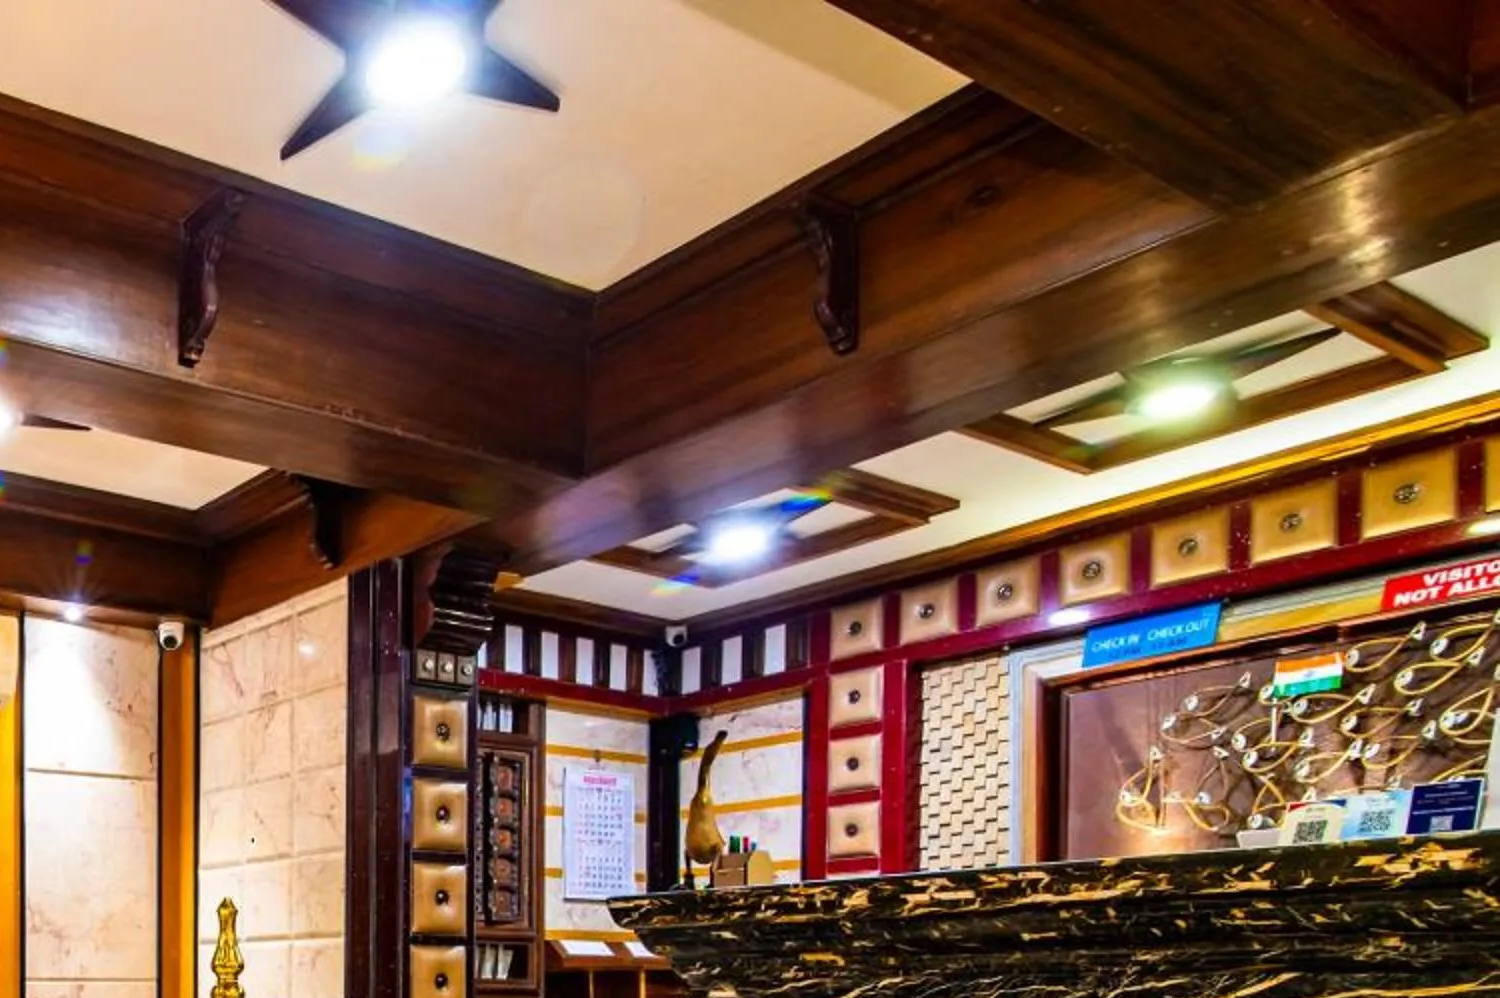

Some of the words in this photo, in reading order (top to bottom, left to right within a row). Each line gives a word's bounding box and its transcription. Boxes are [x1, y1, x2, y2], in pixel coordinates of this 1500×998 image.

[1423, 560, 1500, 586] VISITO
[1393, 585, 1444, 608] NOT
[1091, 636, 1125, 653] CHECK
[1147, 623, 1184, 641] CHECK
[1185, 618, 1211, 633] OUT
